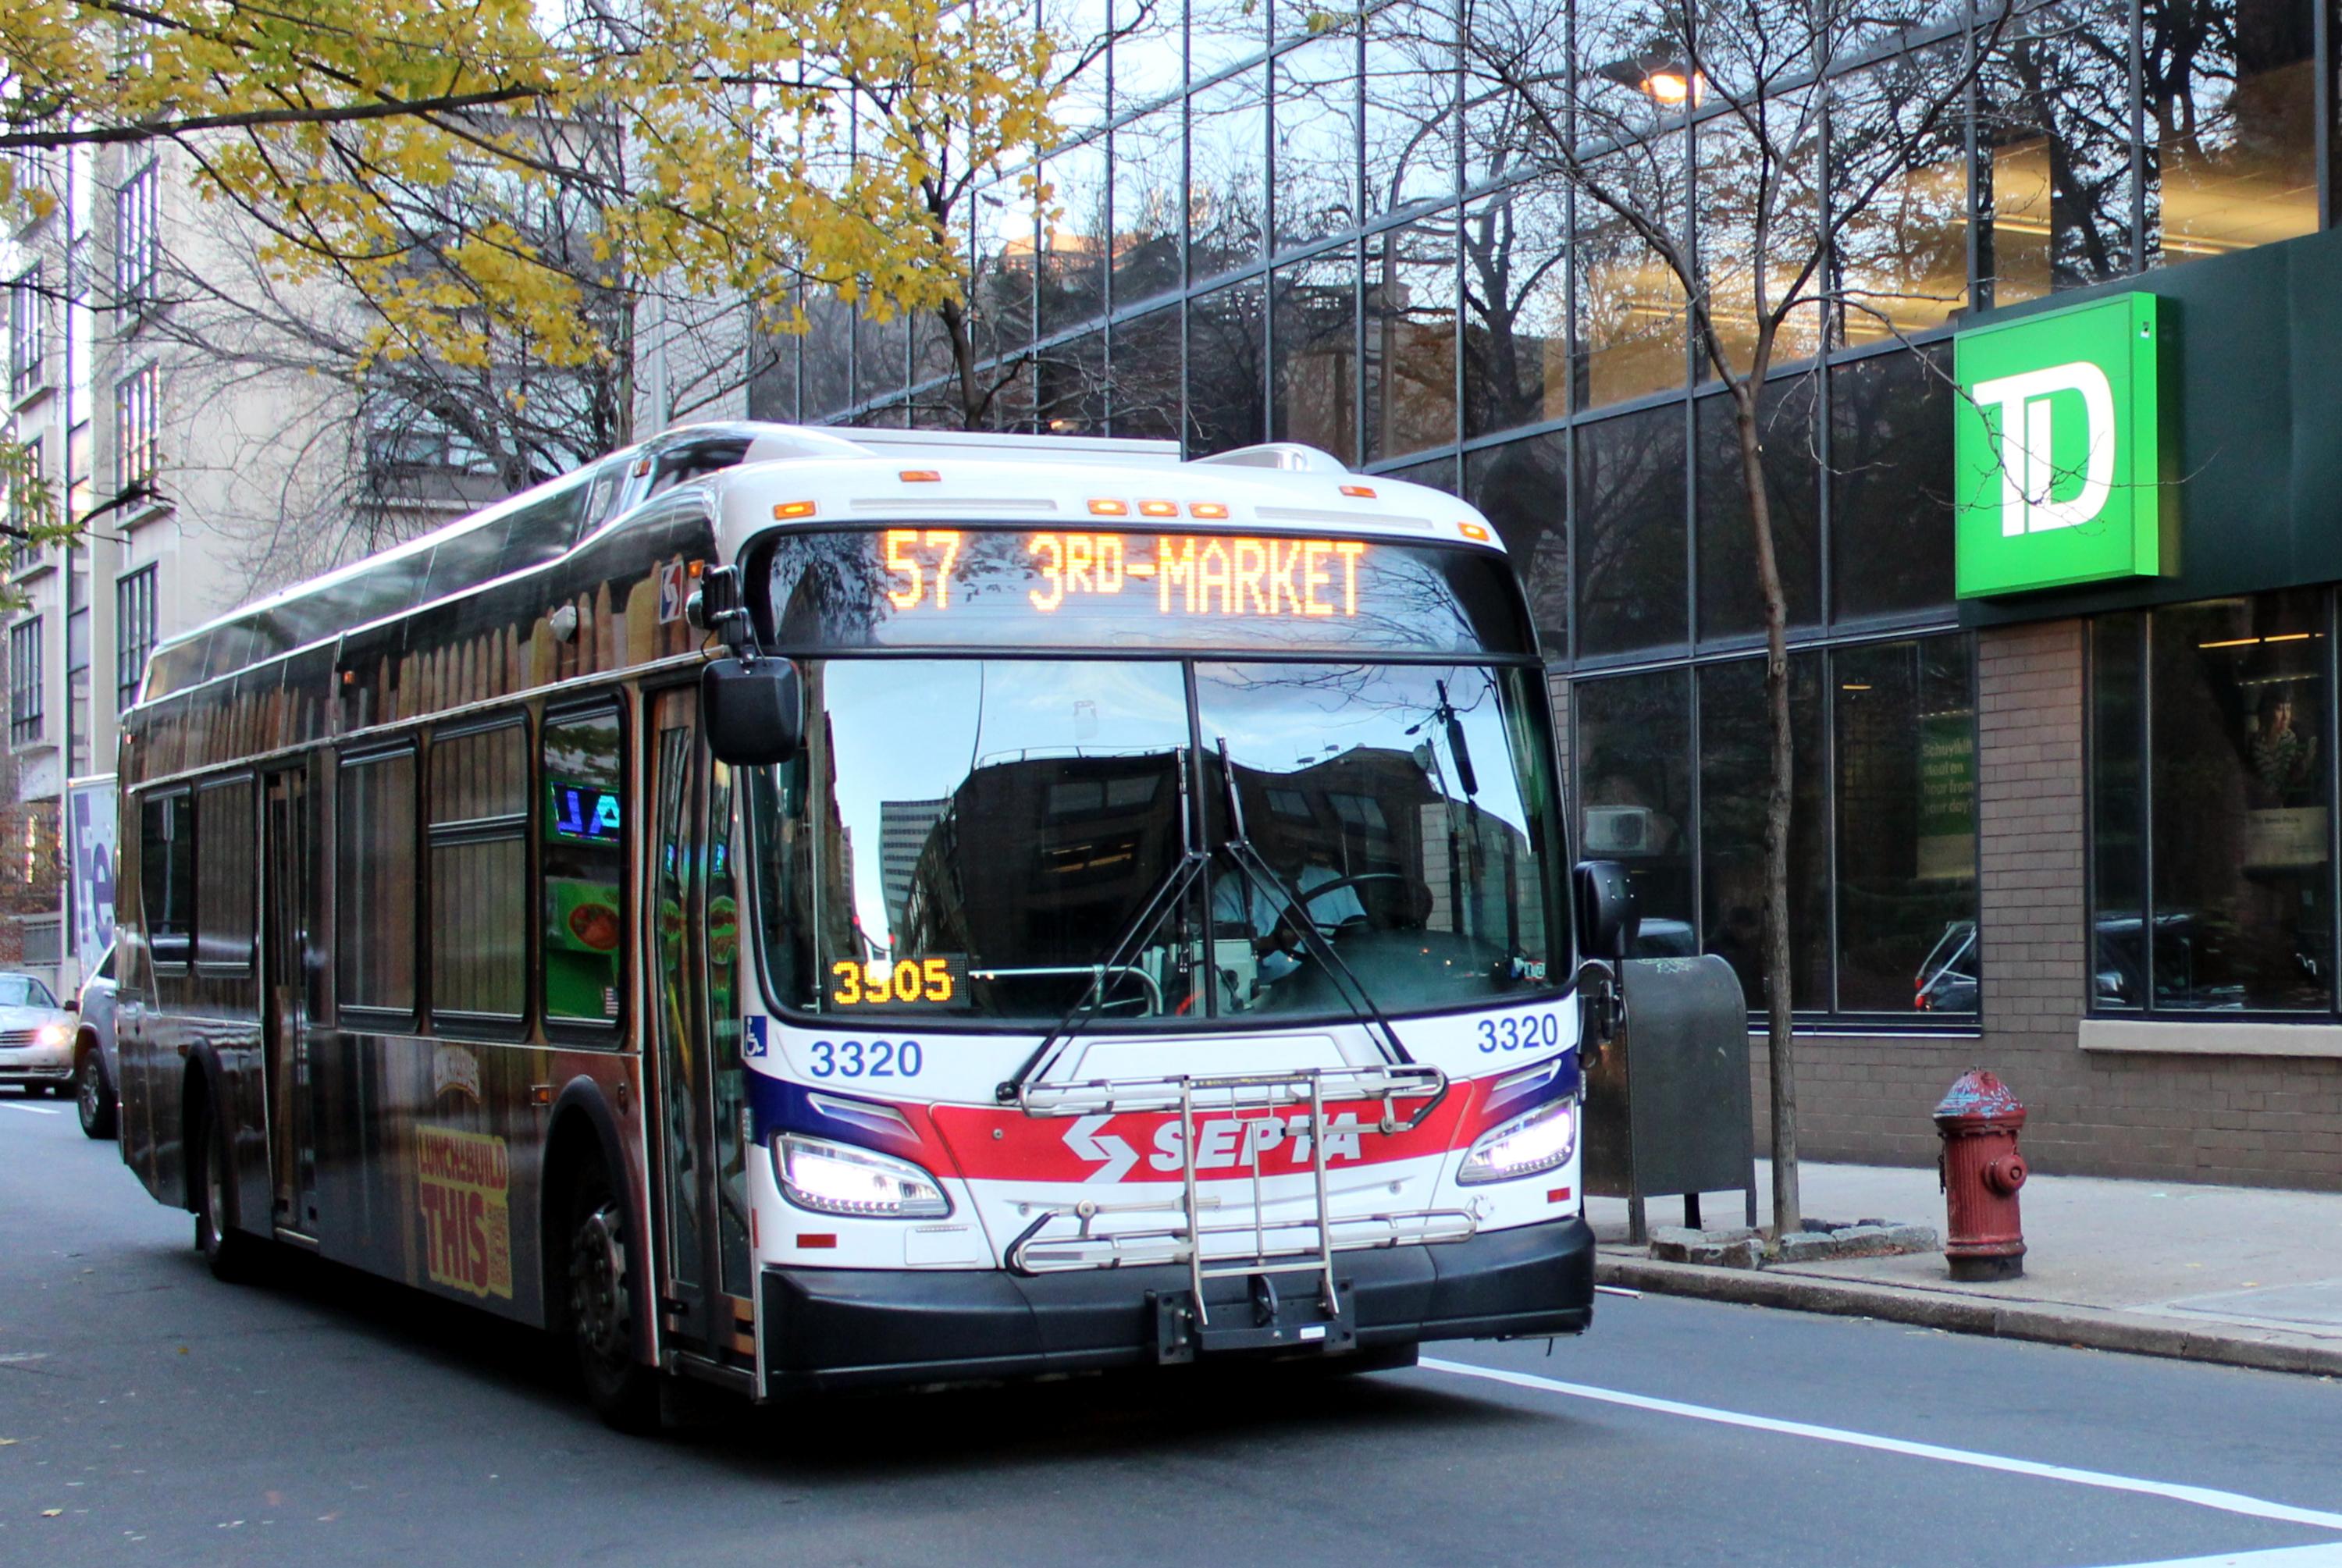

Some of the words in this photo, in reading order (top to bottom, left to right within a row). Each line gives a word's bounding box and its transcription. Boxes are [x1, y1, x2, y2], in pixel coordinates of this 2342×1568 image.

[1972, 360, 2116, 538] TD
[887, 529, 960, 610] 57
[1027, 532, 1365, 617] 3RD-MARKET
[810, 1040, 924, 1078] 3320
[1477, 1013, 1558, 1054] 3320
[1148, 1112, 1362, 1172] SEPTA
[422, 1182, 488, 1288] THIS
